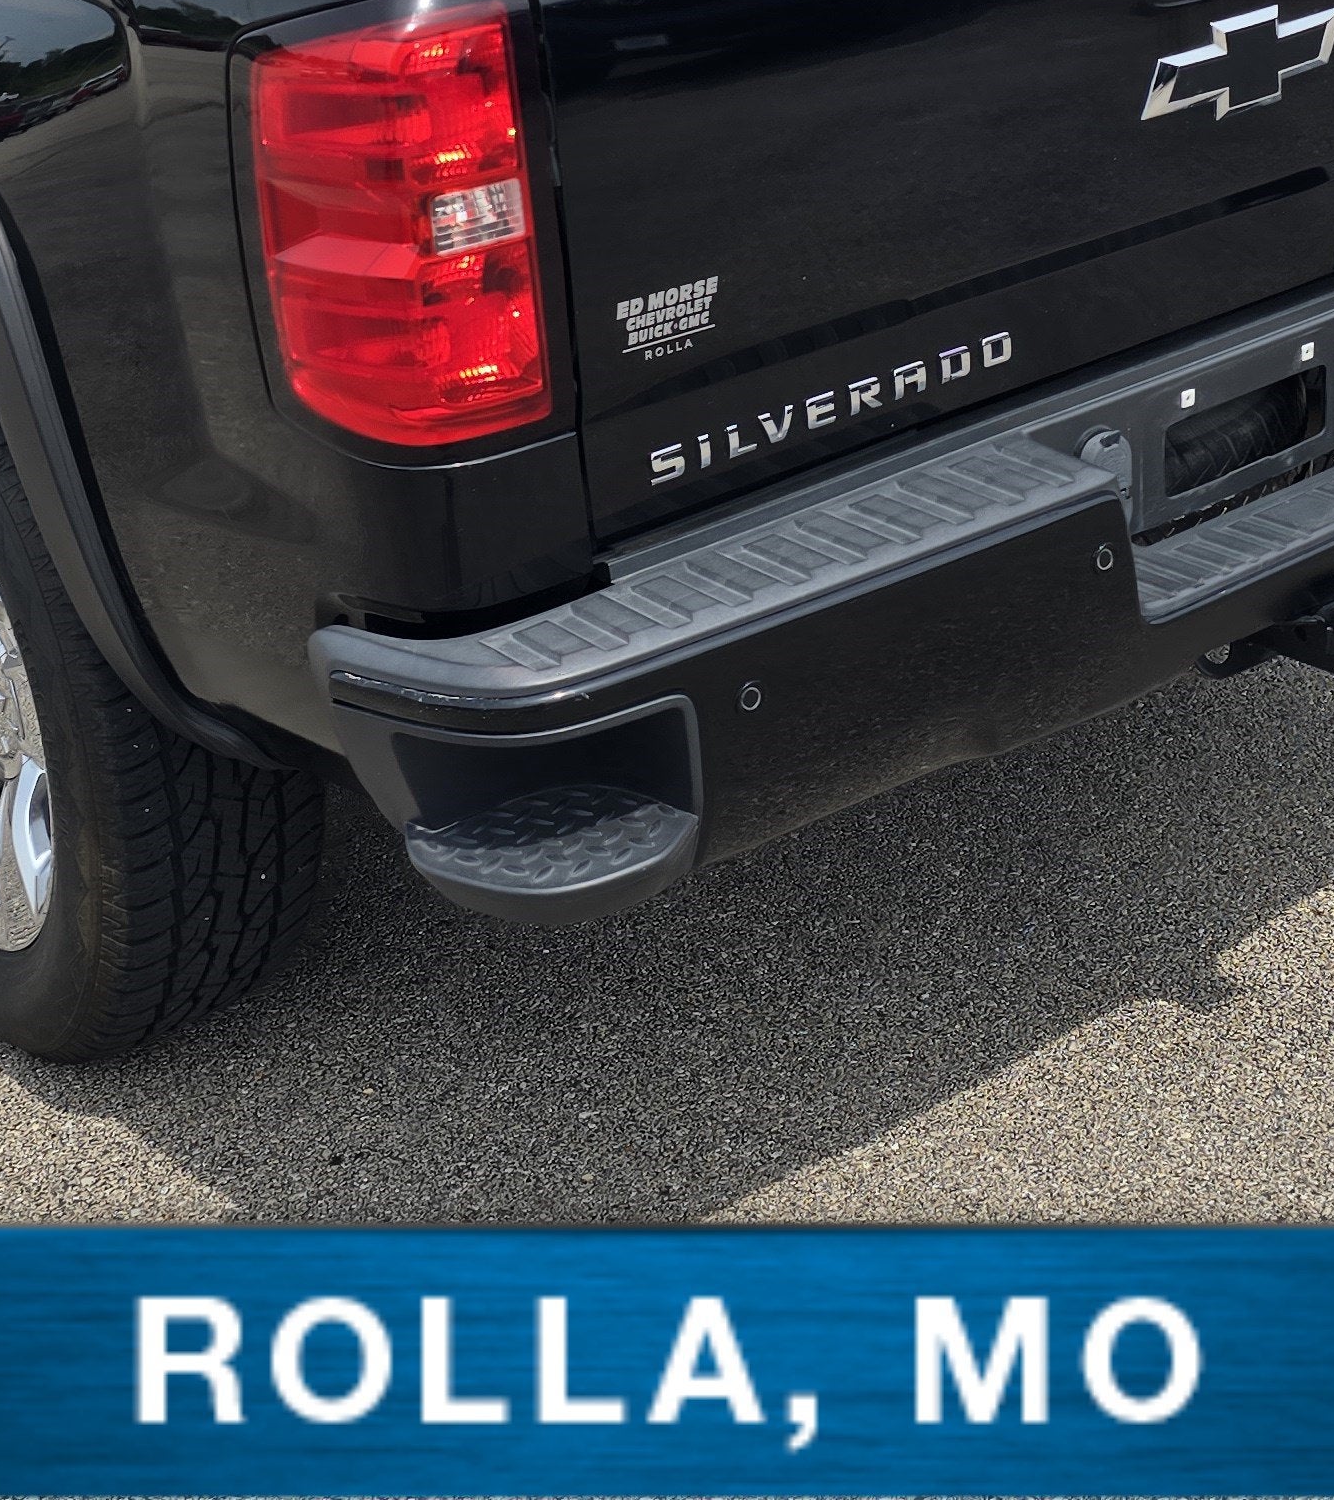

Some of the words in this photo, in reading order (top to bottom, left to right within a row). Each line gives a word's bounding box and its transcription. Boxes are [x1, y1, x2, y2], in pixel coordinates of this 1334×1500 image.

[616, 296, 645, 321] ED
[647, 275, 719, 312] MORSE
[625, 295, 713, 332] CHEVROLET
[644, 338, 694, 361] ROLLA
[650, 331, 1013, 487] SILVERADO
